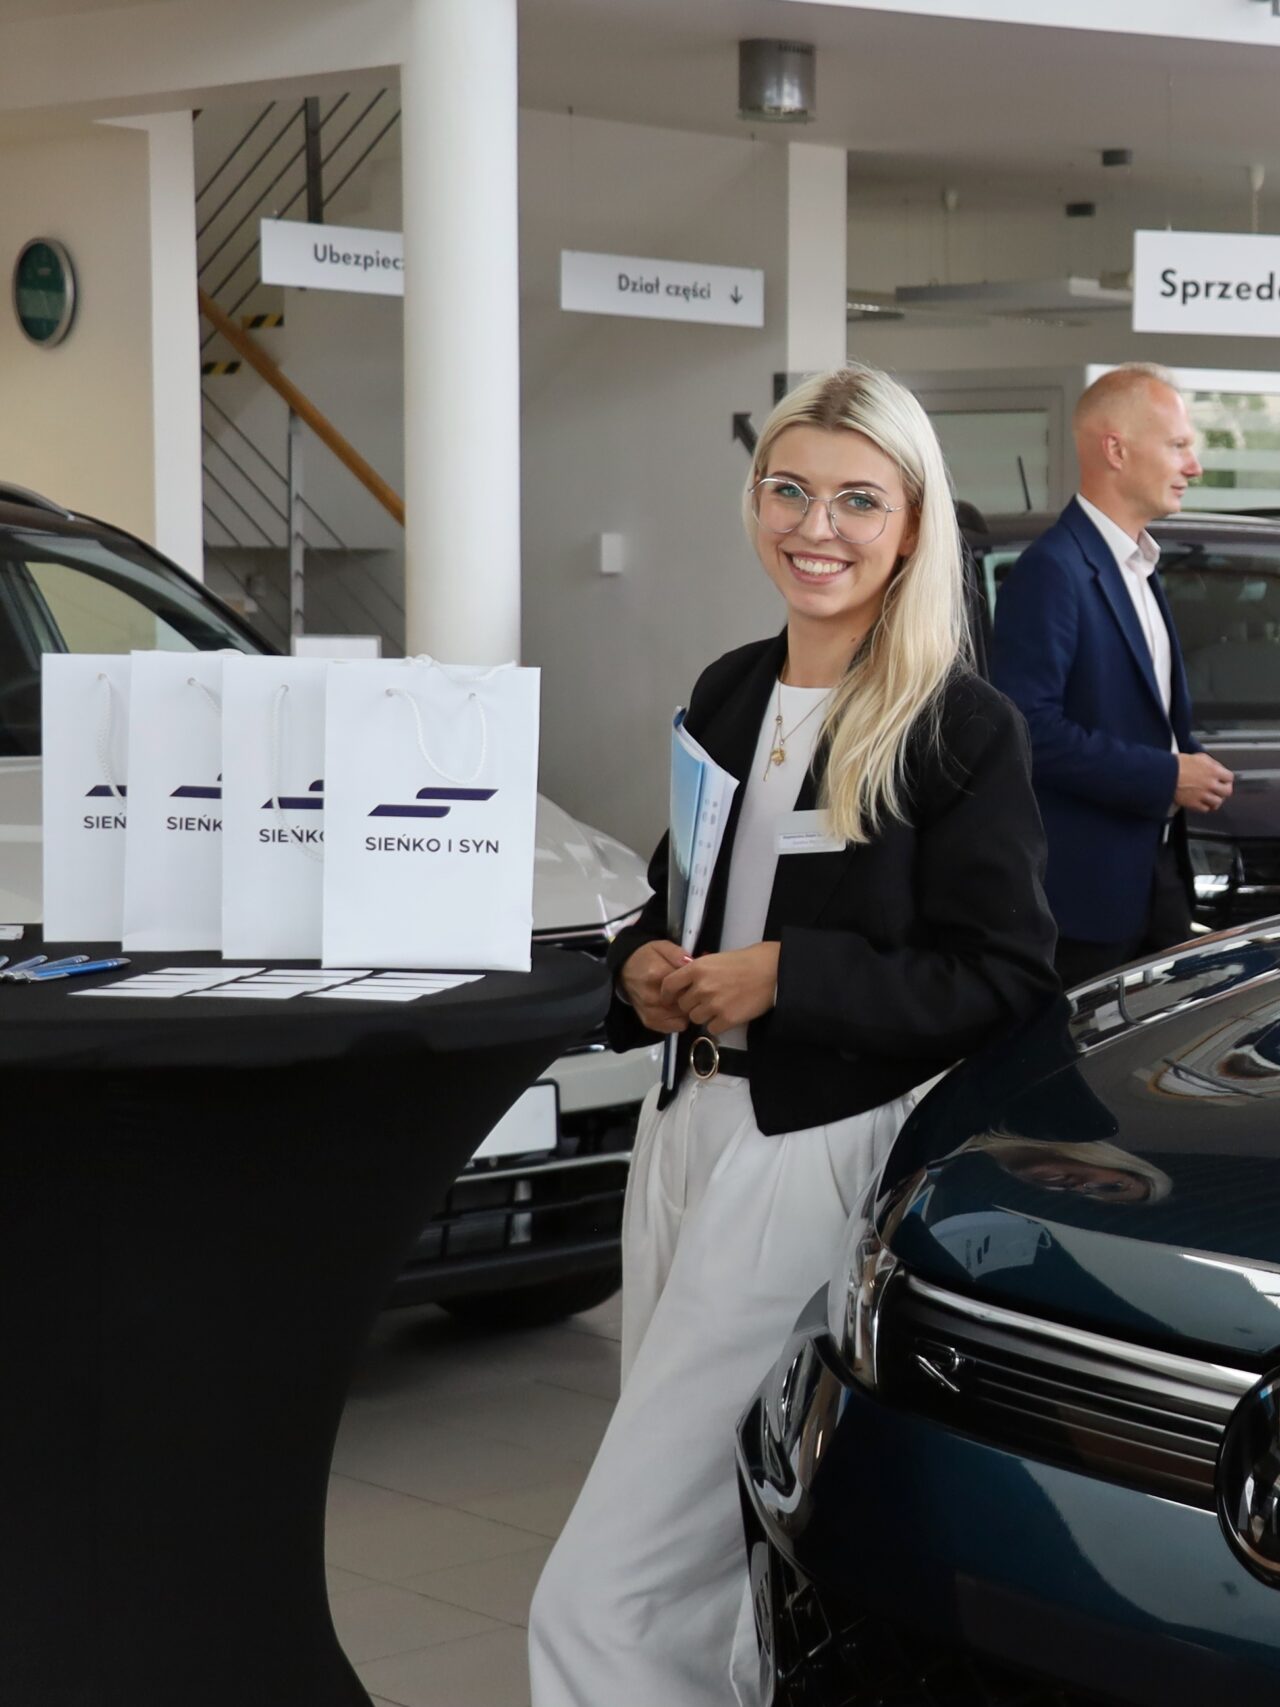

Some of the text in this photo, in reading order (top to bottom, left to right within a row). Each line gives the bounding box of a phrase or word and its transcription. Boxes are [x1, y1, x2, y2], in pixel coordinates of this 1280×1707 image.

[617, 273, 711, 302] Dział części
[365, 833, 499, 854] SIEŃKO I SYN
